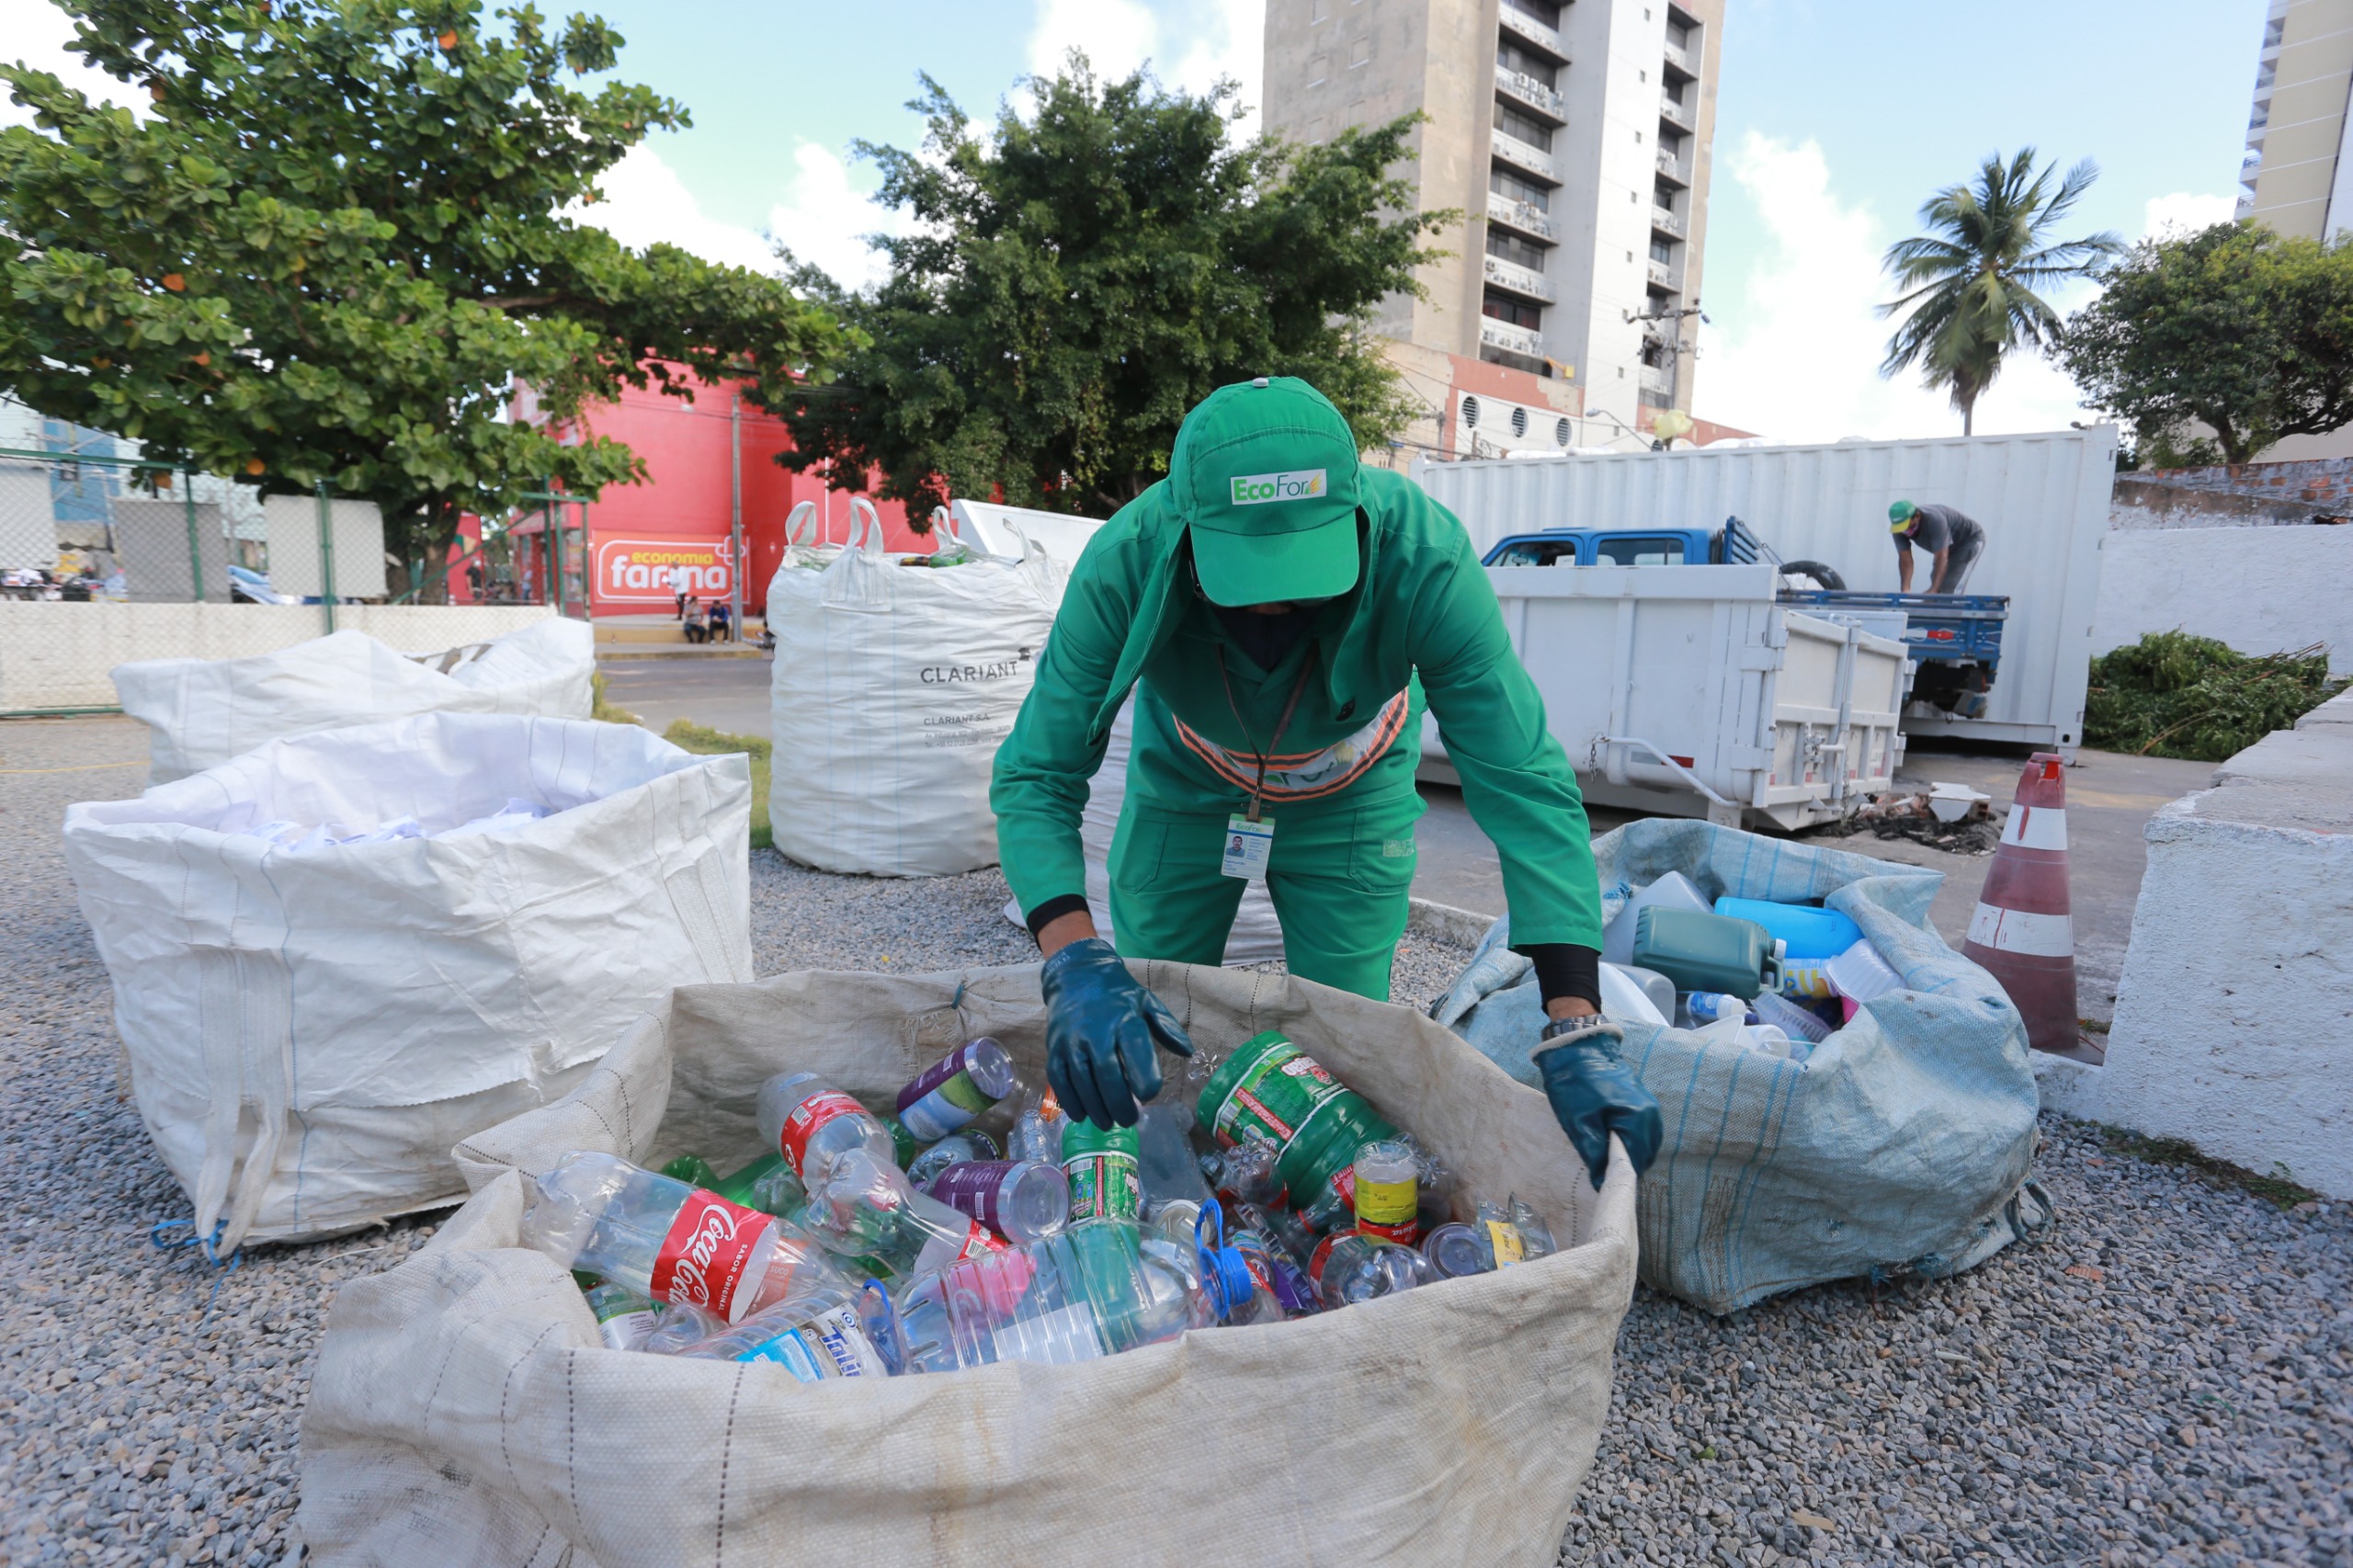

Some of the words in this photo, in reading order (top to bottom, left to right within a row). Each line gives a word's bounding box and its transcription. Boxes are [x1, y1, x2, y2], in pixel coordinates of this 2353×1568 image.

[1233, 474, 1308, 501] EcoFor
[631, 551, 713, 565] economia
[920, 660, 1017, 683] CLARIANT
[924, 714, 973, 726] CLARIANT
[731, 1244, 748, 1273] SABOR
[770, 1265, 789, 1276] SUCO
[719, 1275, 733, 1311] ORIGINAL
[821, 1325, 862, 1377] Tali
